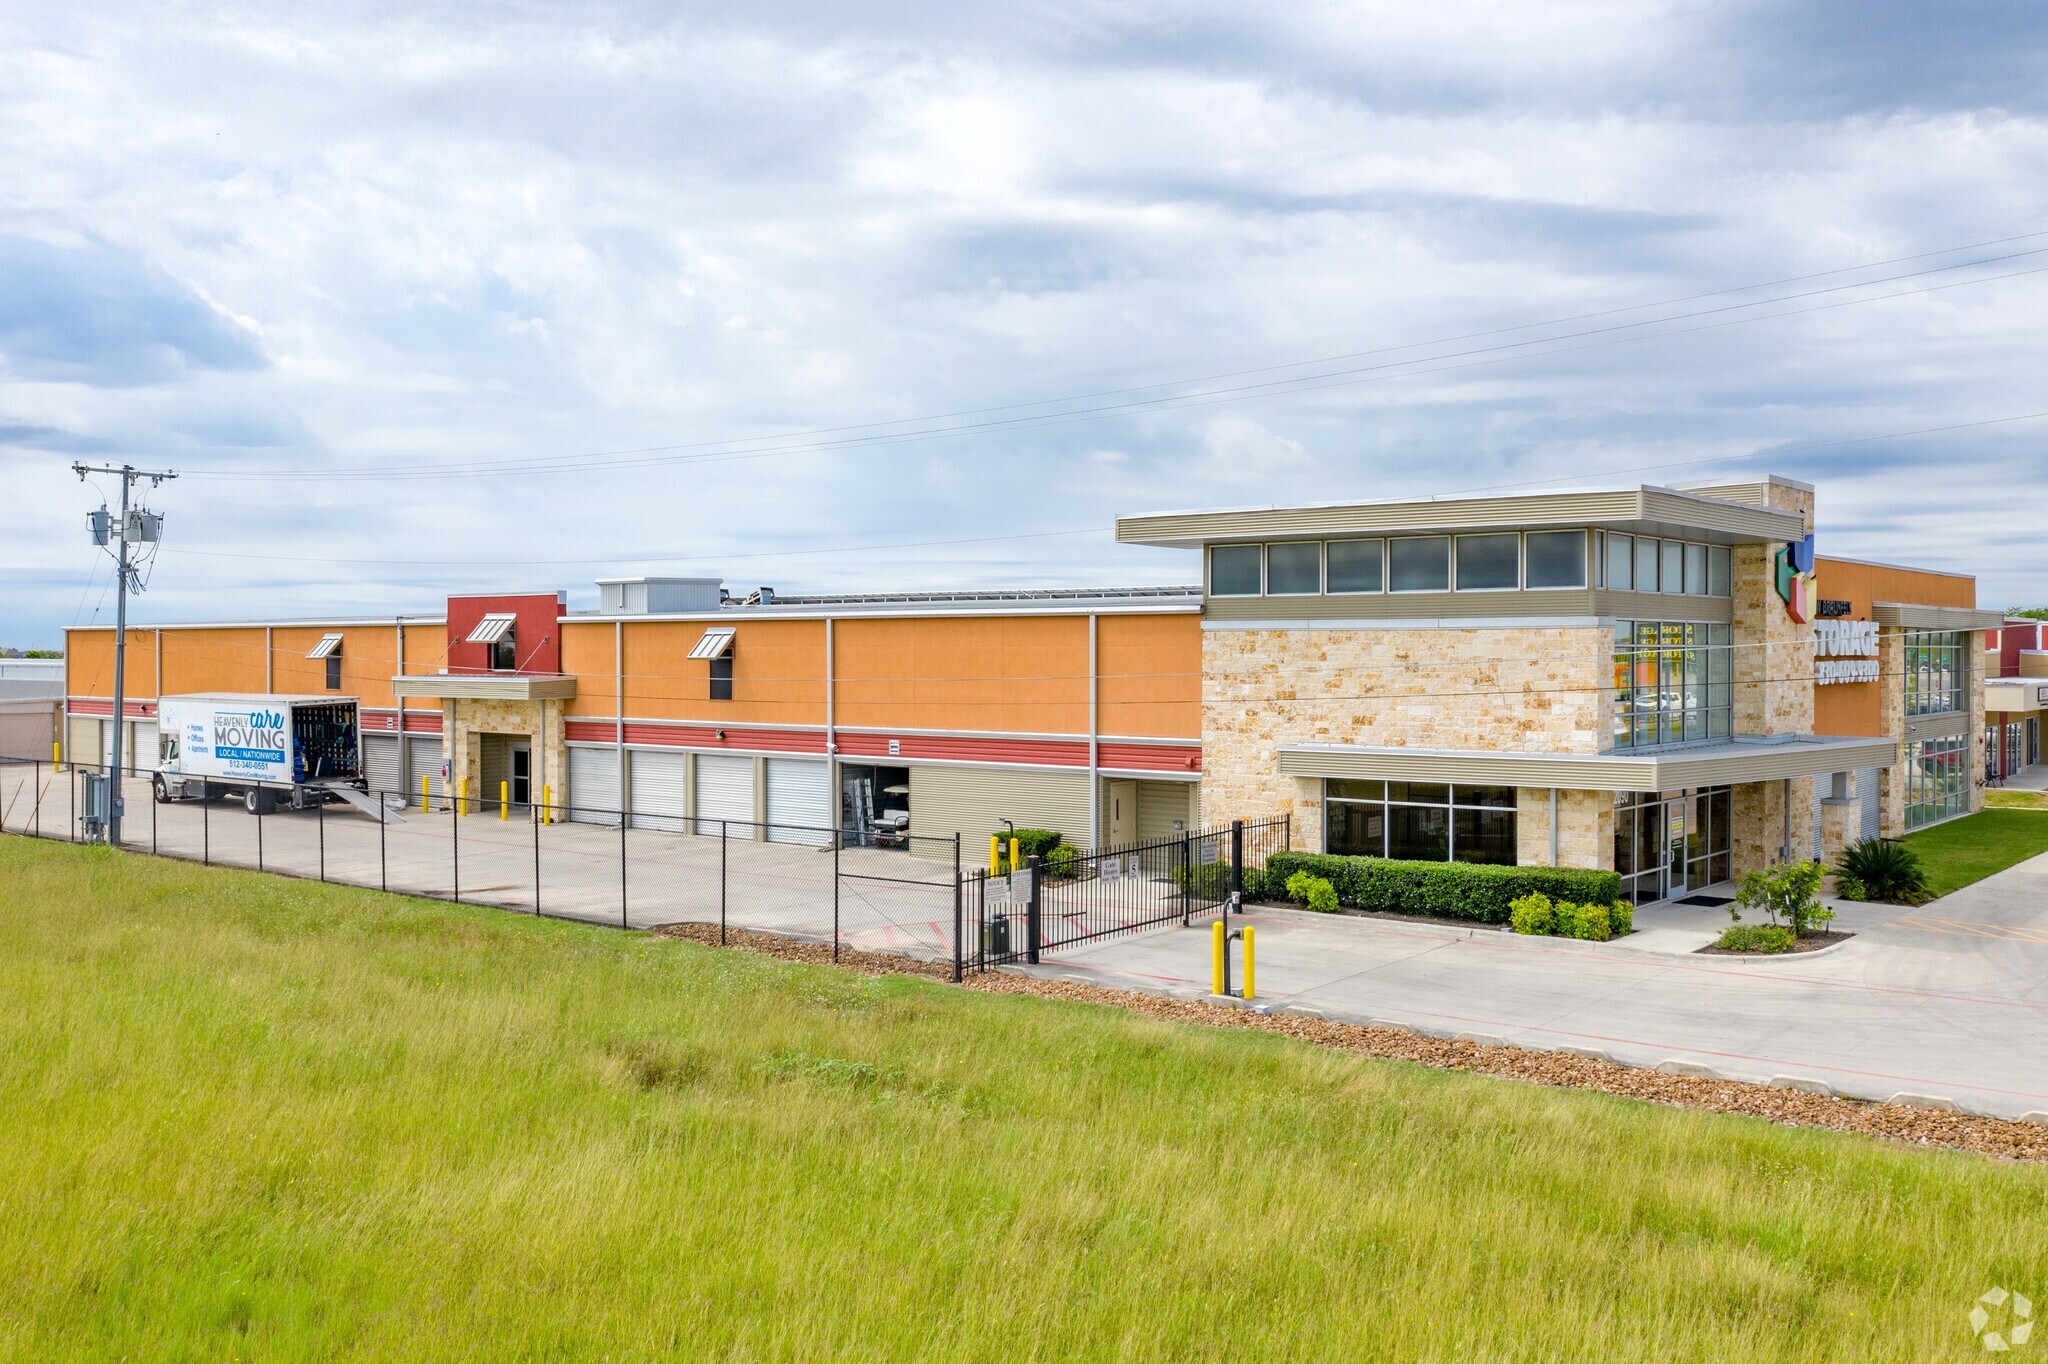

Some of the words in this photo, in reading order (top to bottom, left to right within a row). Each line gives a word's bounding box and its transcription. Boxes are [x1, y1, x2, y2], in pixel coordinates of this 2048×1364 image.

[214, 716, 248, 727] HEAVENLY
[250, 709, 284, 729] care
[214, 727, 285, 749] MOVING
[219, 749, 239, 758] LOCAL
[243, 751, 281, 761] NATIONWIDE
[229, 760, 268, 770] 512-340-0551
